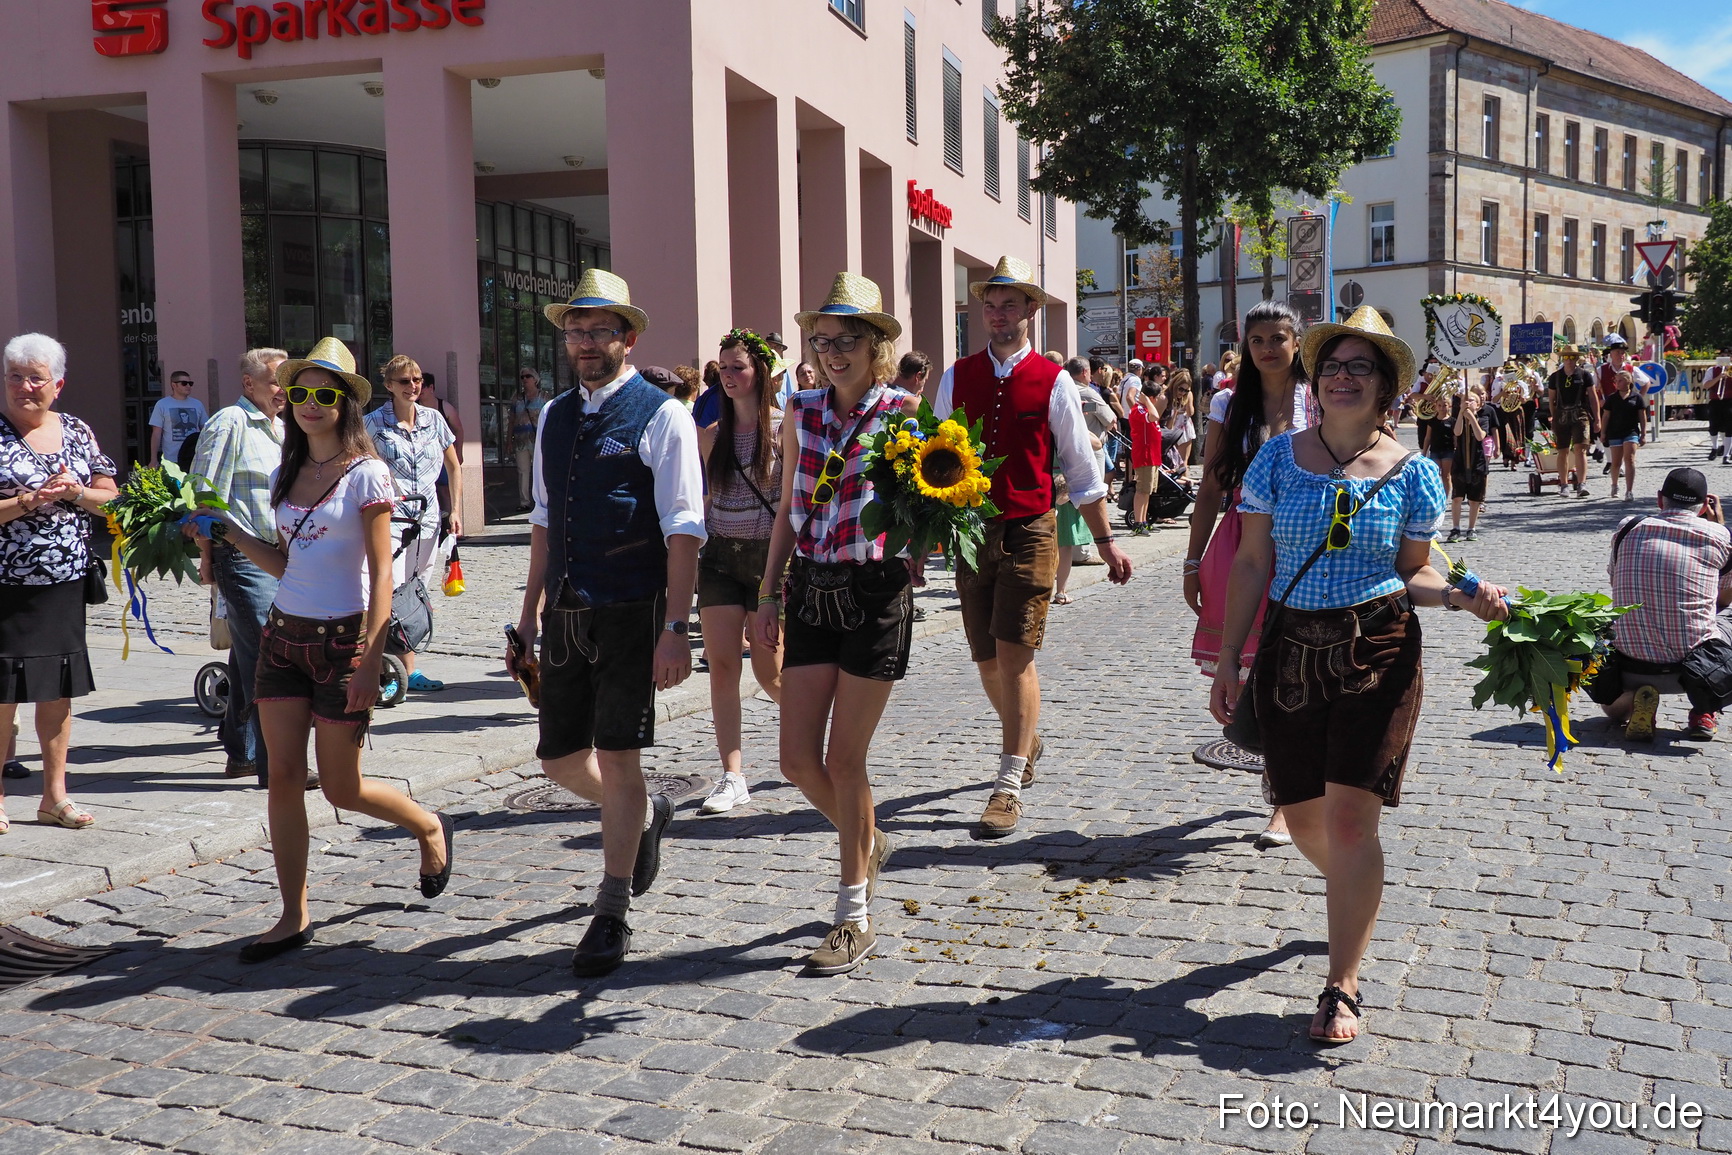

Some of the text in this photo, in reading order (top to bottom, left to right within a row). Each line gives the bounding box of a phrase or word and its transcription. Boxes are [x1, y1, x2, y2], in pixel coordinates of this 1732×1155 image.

[201, 0, 485, 60] Sparkasse
[907, 180, 952, 228] Sparkasse
[1300, 228, 1313, 237] 30
[503, 269, 576, 298] wochenblatt
[124, 333, 138, 343] der
[1102, 333, 1117, 342] AOK
[1433, 346, 1478, 366] BLASKAPELLE
[1477, 338, 1499, 362] PÖLLING
